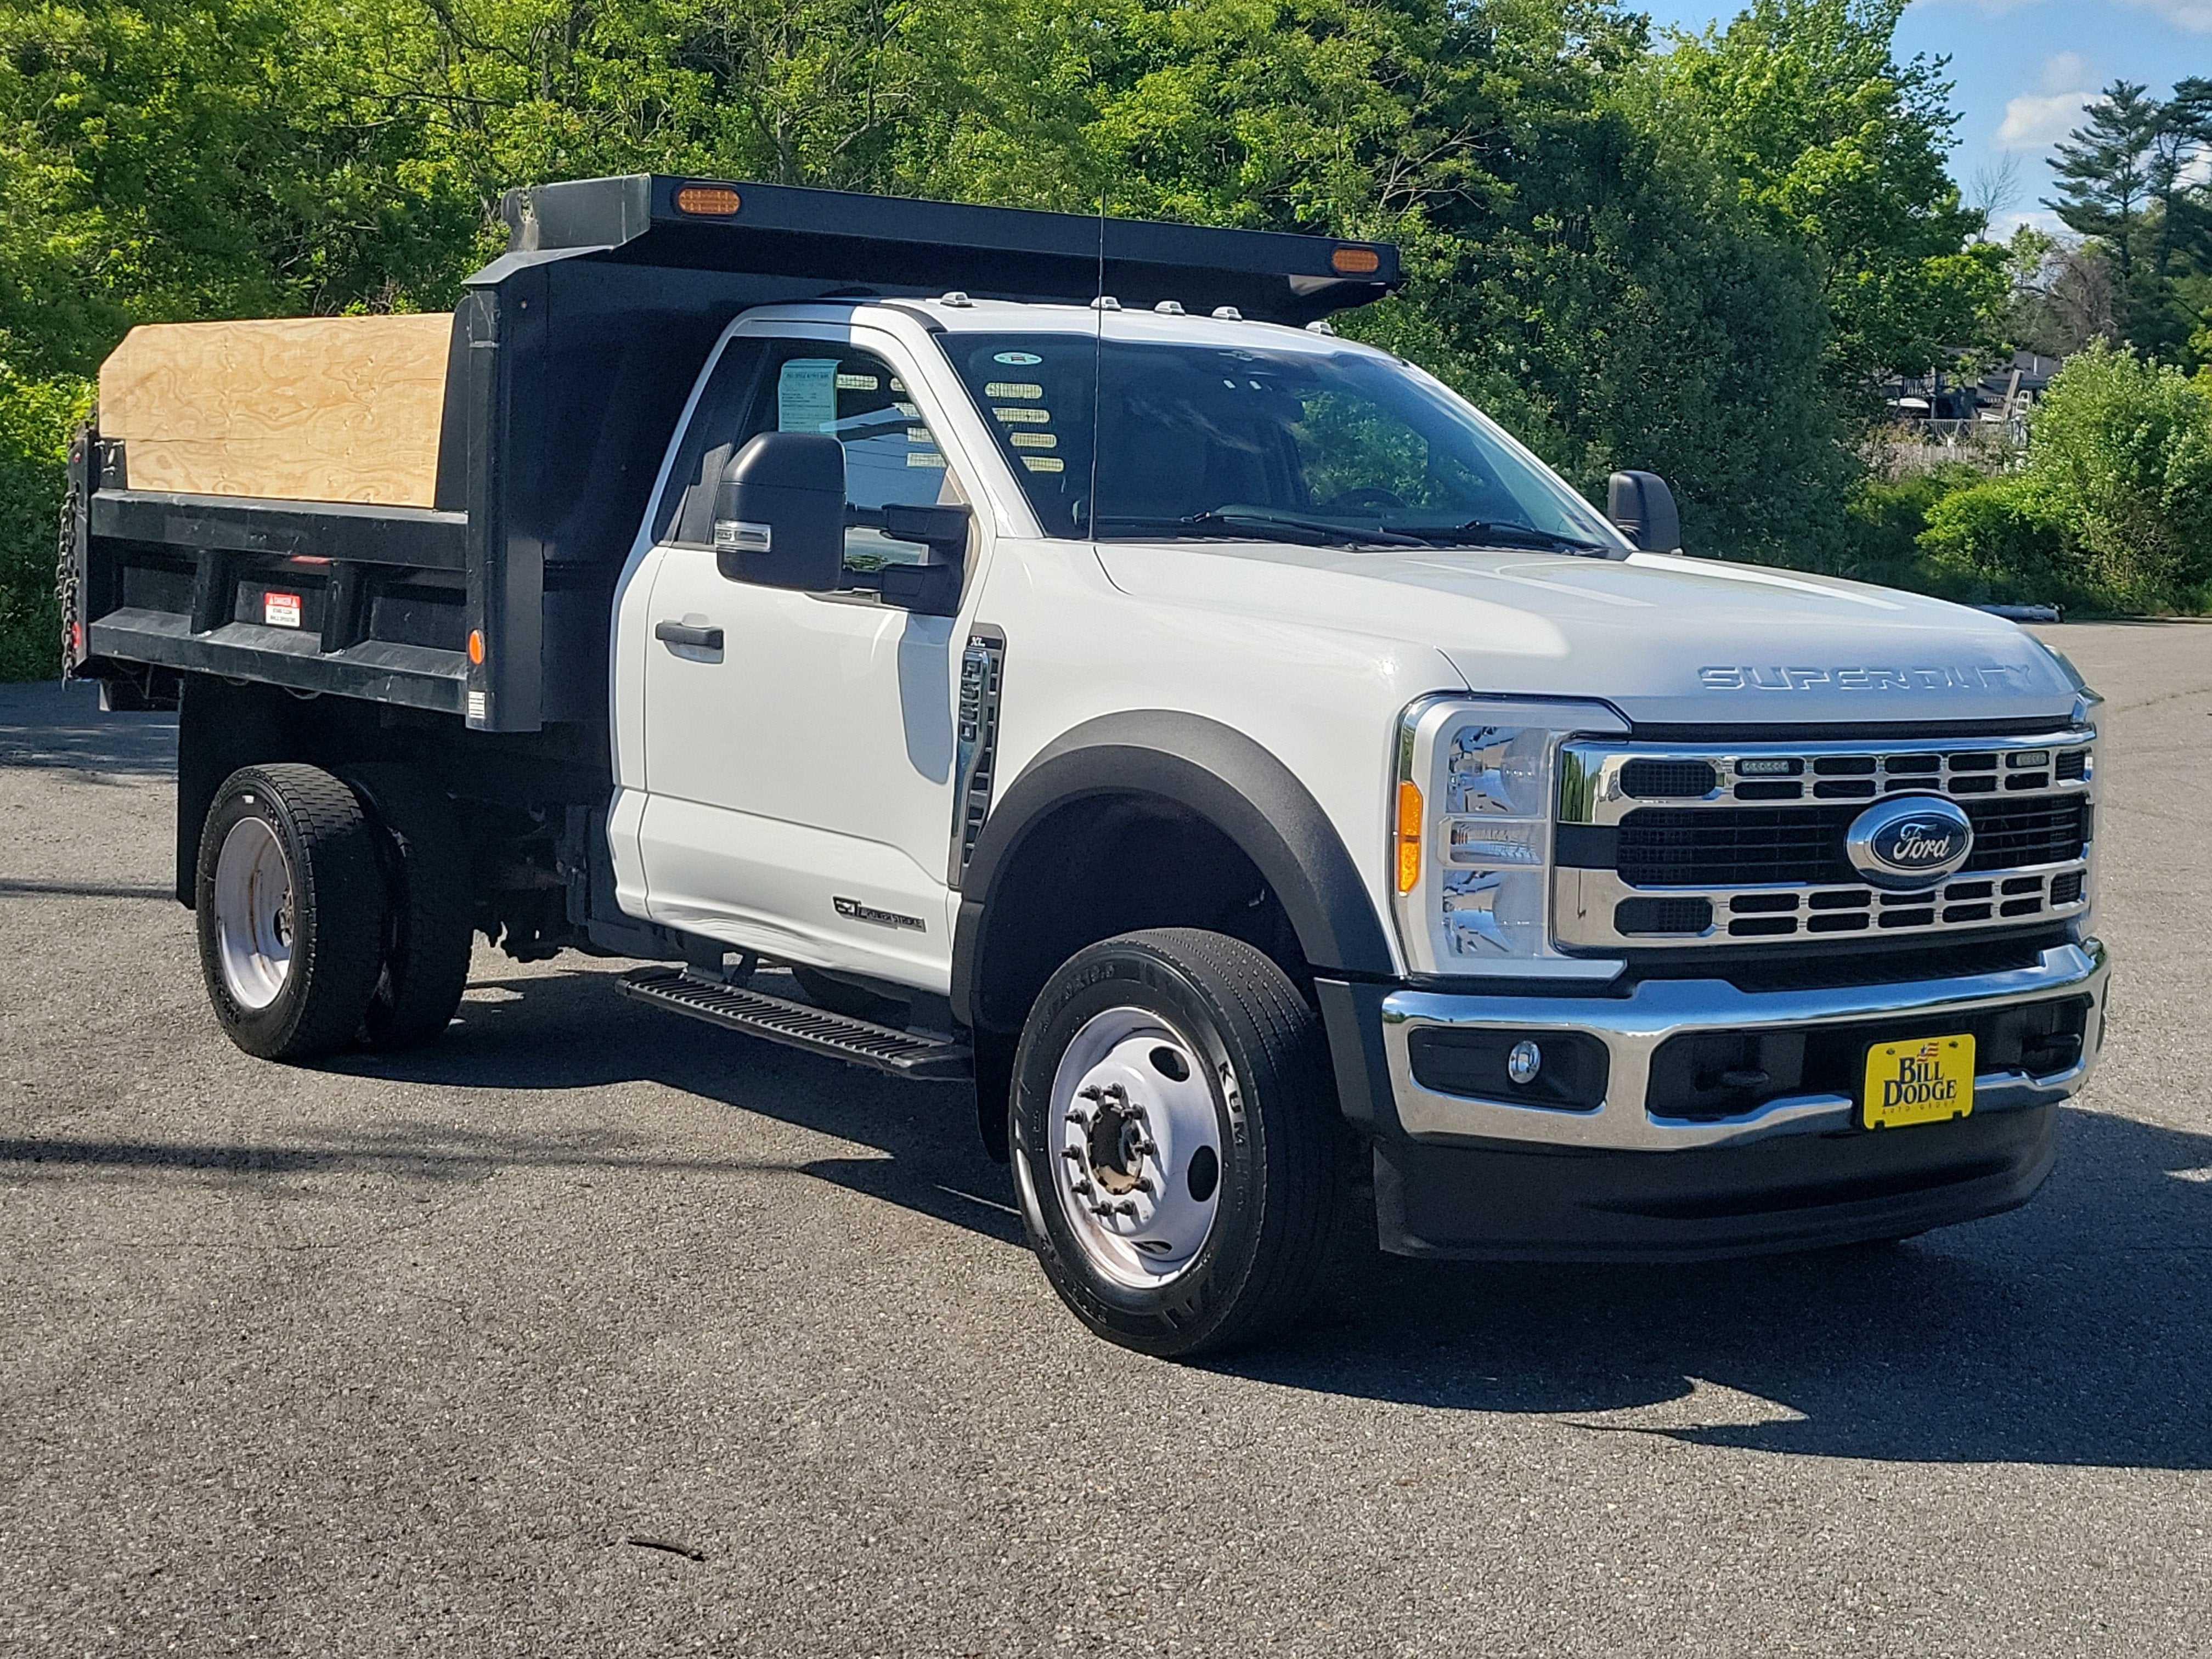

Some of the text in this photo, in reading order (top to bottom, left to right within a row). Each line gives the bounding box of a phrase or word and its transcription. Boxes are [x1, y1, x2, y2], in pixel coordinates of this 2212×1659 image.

[970, 636, 985, 647] XL
[1893, 822, 1951, 860] Ford
[1883, 1079, 1957, 1107] DODGE
